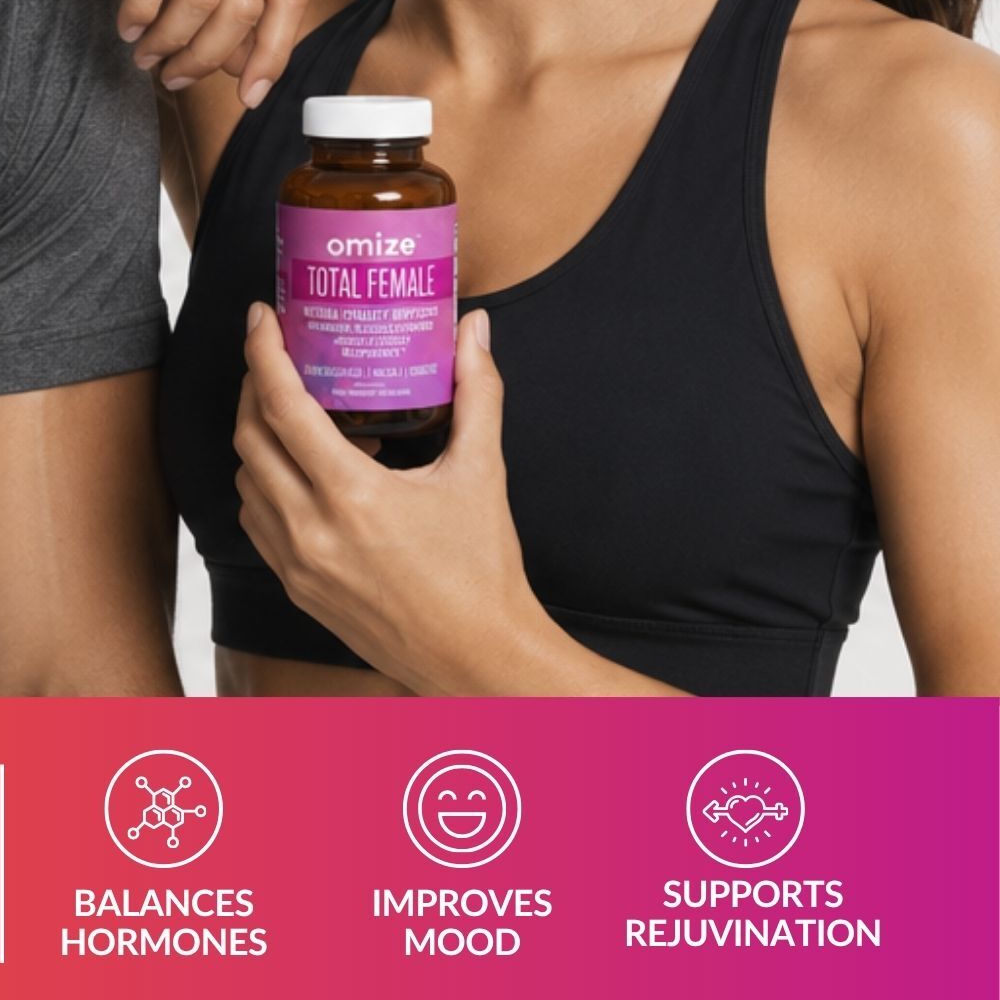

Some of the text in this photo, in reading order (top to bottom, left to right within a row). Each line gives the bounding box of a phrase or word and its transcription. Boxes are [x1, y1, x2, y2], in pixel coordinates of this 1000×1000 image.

[326, 232, 416, 258] omize
[307, 264, 436, 299] TOTAL FEMALE
